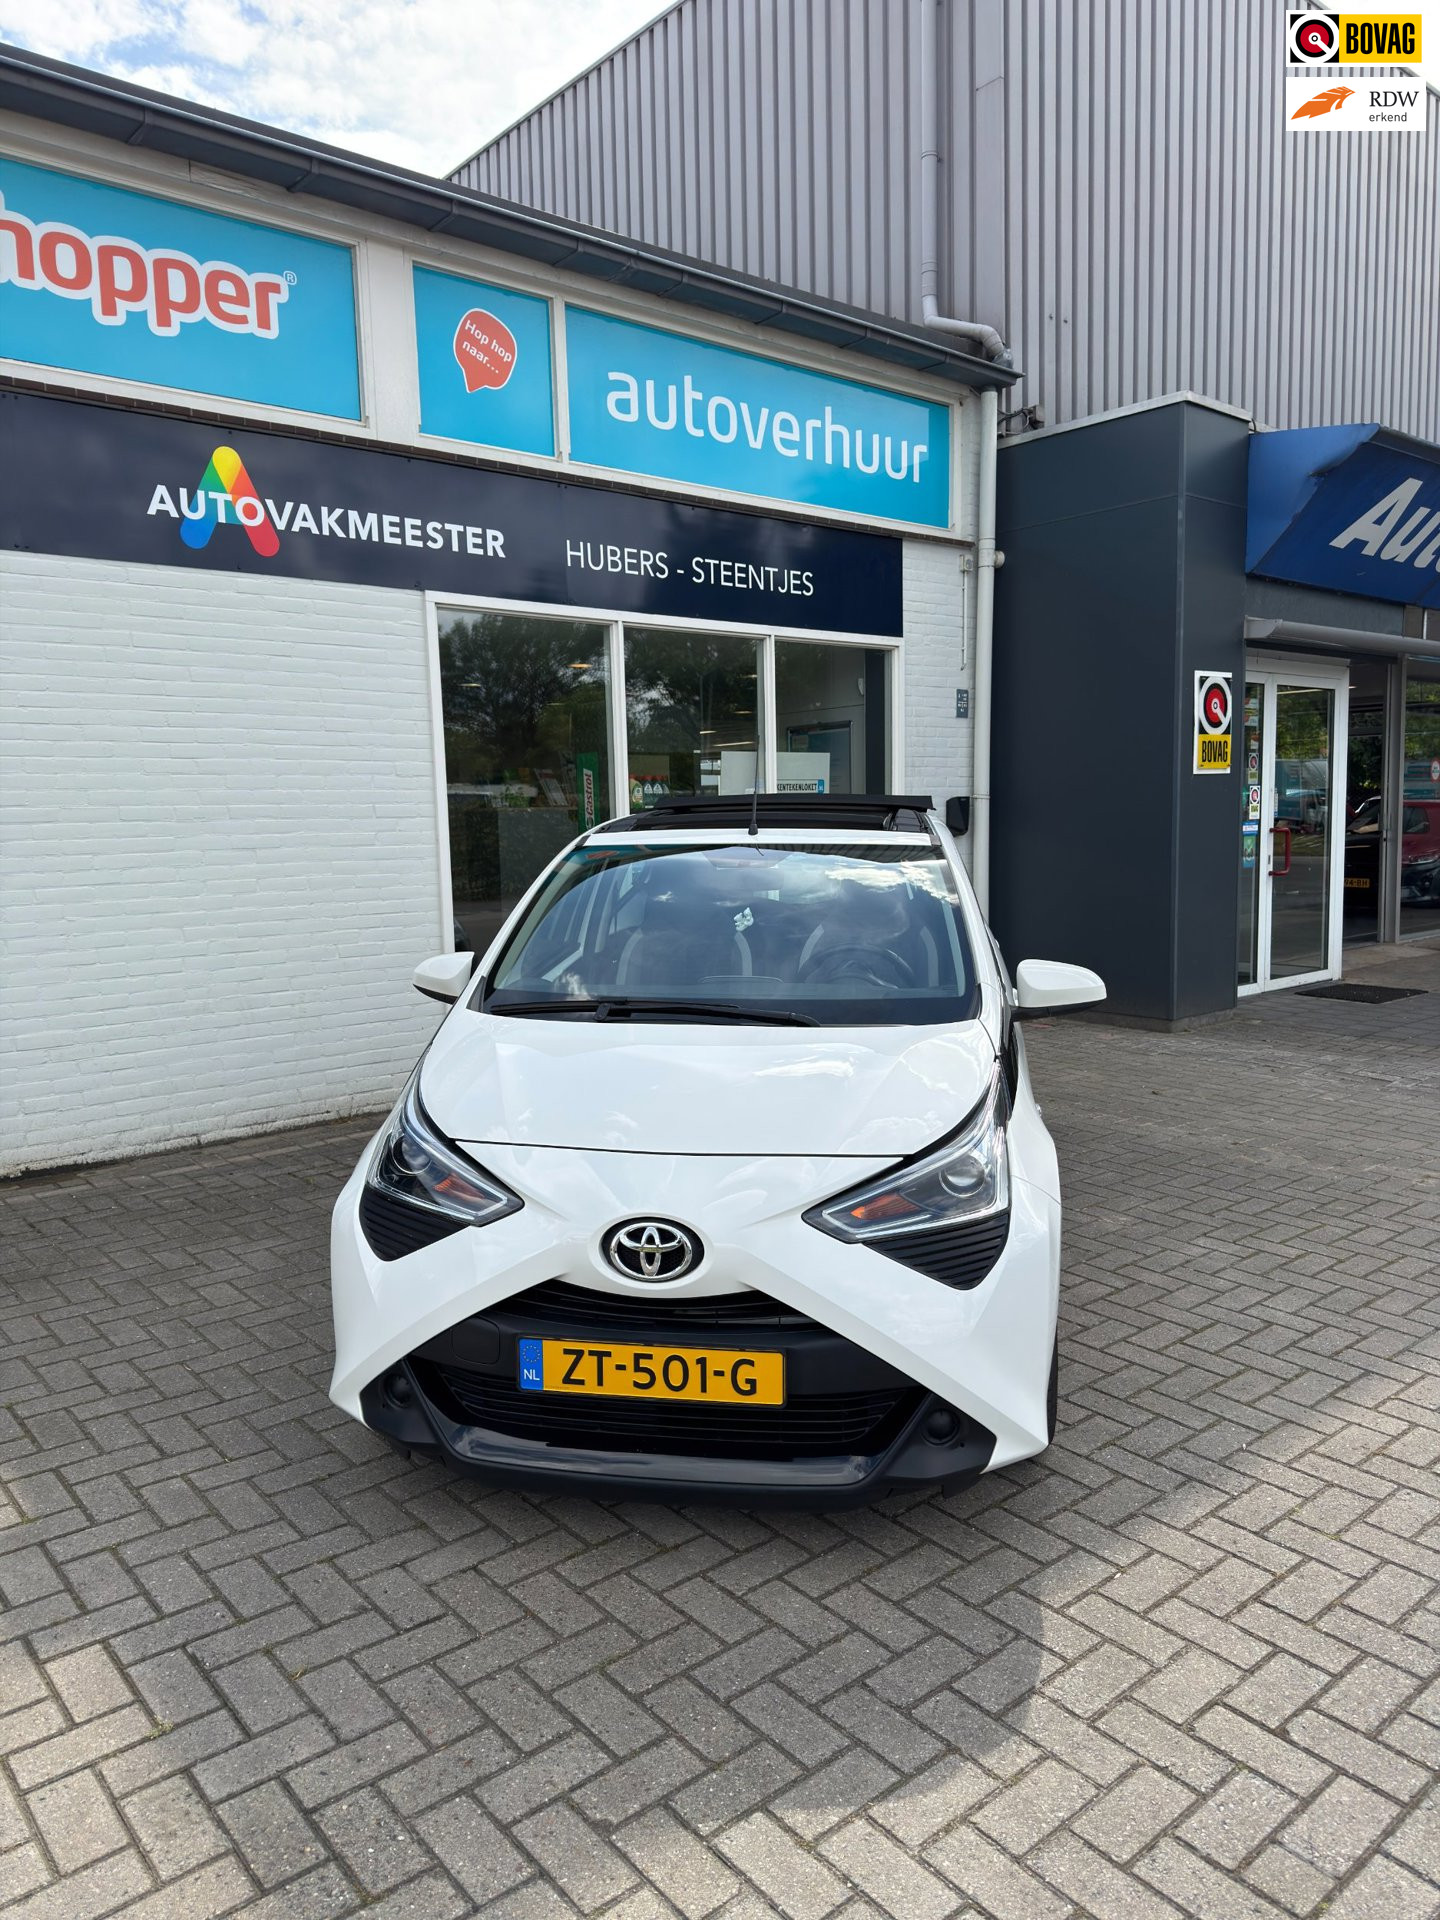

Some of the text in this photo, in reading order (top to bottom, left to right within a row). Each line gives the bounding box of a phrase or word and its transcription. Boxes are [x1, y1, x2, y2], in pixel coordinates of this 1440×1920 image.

[461, 341, 500, 374] naar...
[464, 319, 513, 363] Hop hop
[606, 370, 929, 484] autoverhuur
[146, 484, 506, 558] AUTOVAKMEESTER
[1328, 477, 1440, 573] Aut
[565, 538, 669, 579] HUBERS
[691, 556, 814, 597] STEENTJES
[1201, 740, 1228, 763] BOVAG
[584, 772, 594, 816] Castrol
[523, 1347, 758, 1397] NL ZT-501-G
